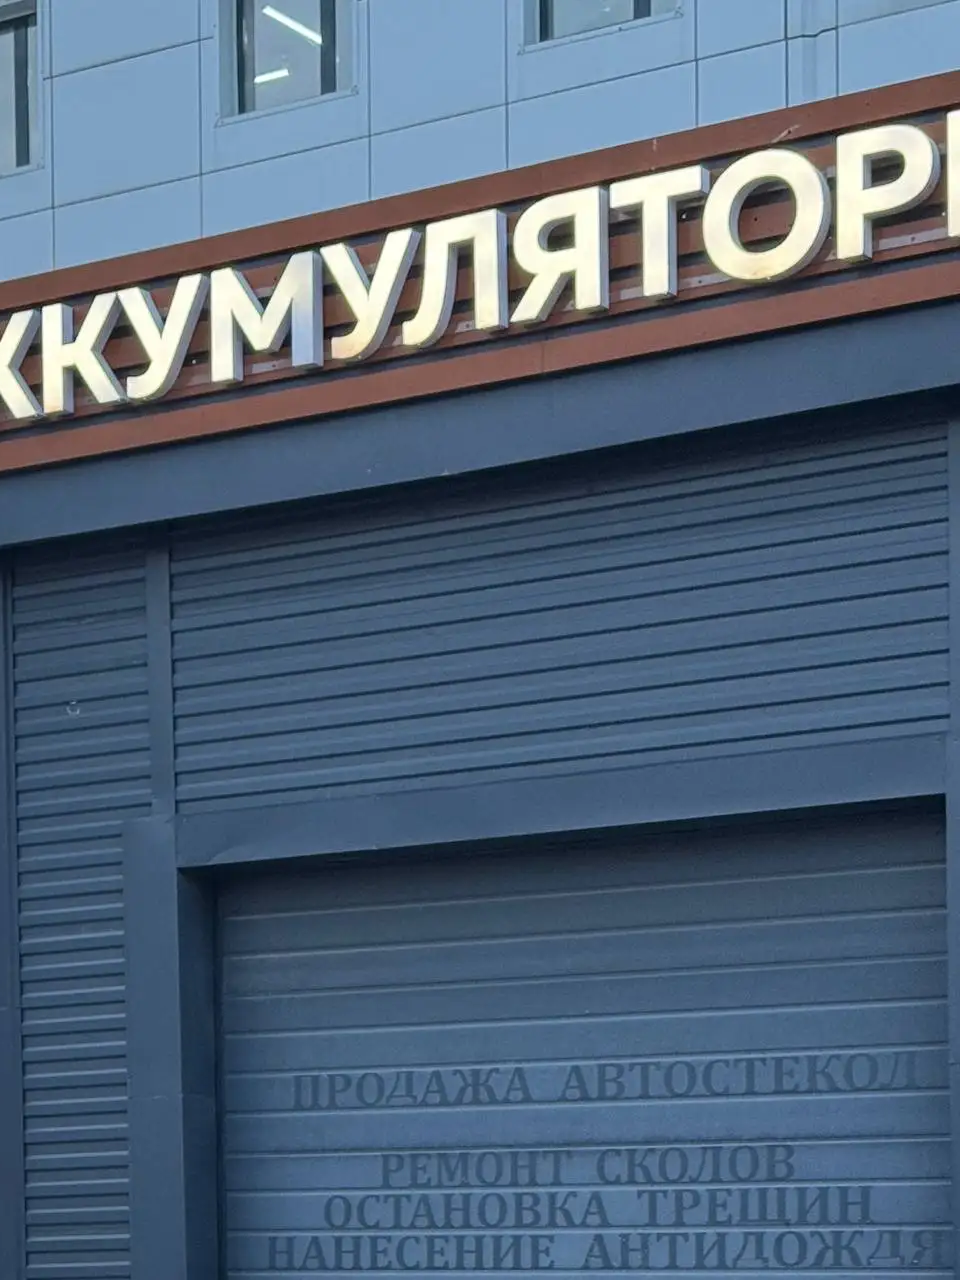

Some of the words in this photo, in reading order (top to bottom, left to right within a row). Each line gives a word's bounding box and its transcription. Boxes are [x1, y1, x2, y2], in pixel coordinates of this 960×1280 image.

[292, 1067, 535, 1111] ПРОДАЖА
[557, 1052, 922, 1102] АВТОСТЕКОЛ
[380, 1149, 572, 1188] РЕМОНТ
[596, 1143, 797, 1185] СКОЛОВ
[323, 1190, 611, 1229] ОСТАНОВКА
[637, 1185, 873, 1227] ТРЕЩИН
[267, 1234, 555, 1271] НАНЕСЕНИЕ
[583, 1229, 946, 1270] АНТИДОЖДЯ
